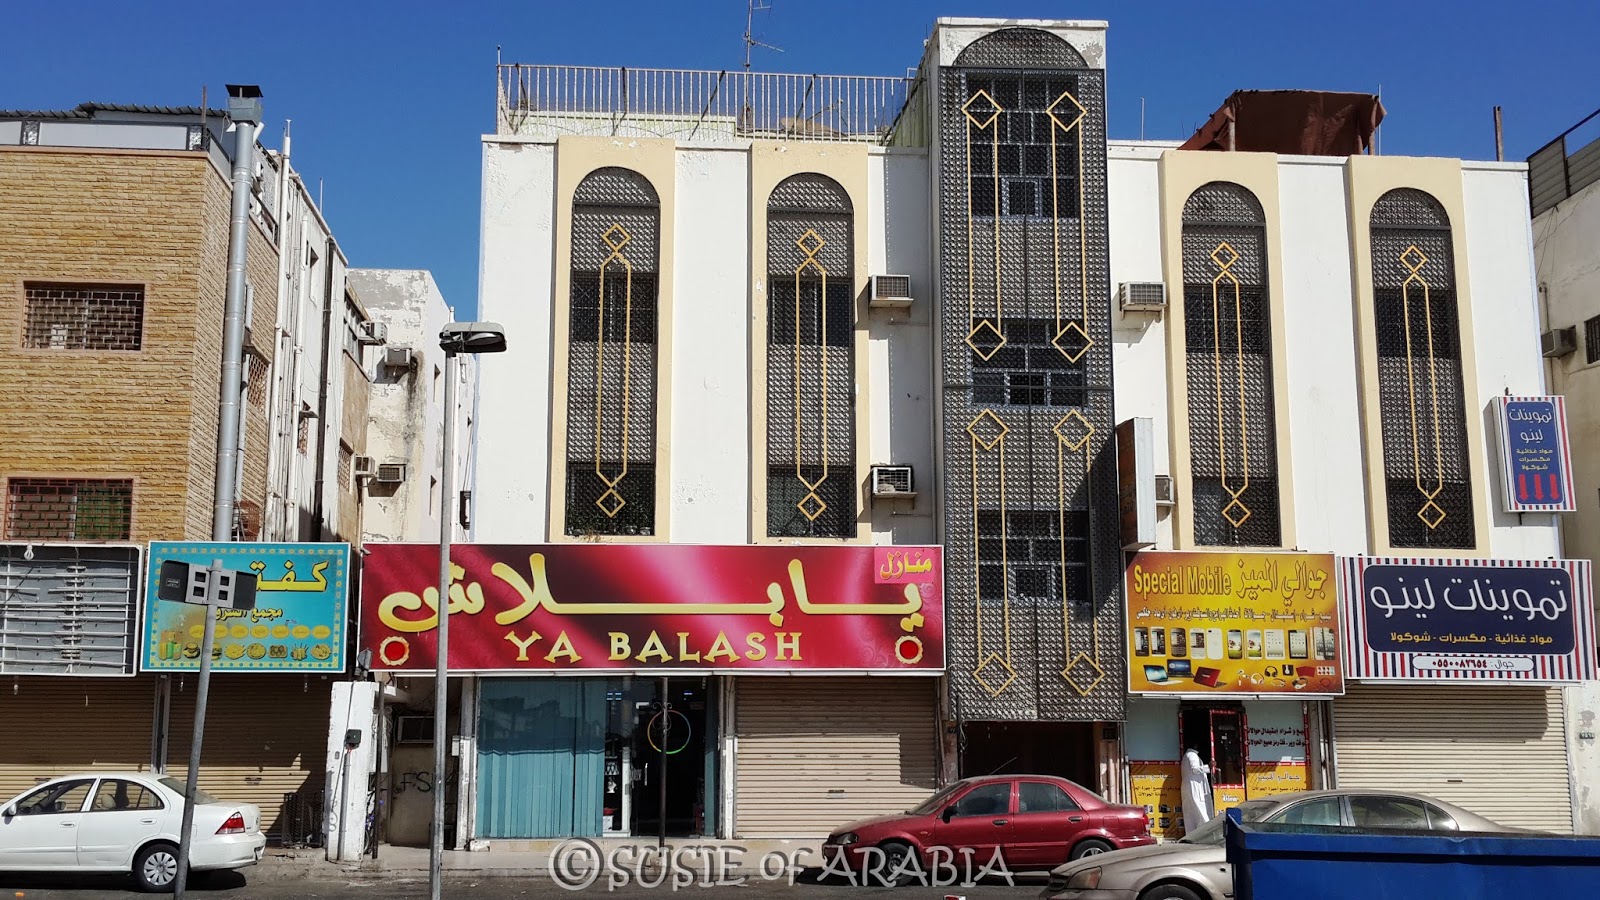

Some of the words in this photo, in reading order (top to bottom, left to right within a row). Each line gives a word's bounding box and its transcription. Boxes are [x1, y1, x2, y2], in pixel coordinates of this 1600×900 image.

[880, 550, 933, 580] منازل
[1134, 564, 1184, 601] Special
[1187, 565, 1232, 596] Mobile
[1281, 559, 1329, 607] جوالي
[1369, 576, 1436, 619] لينو
[1443, 577, 1568, 621] تموينات
[503, 629, 583, 664] YA
[607, 629, 803, 664] BALASH
[1390, 631, 1431, 643] شوكولا
[1439, 633, 1487, 643] مكسرات
[1495, 632, 1527, 645] غذائية
[1529, 634, 1553, 645] مواد
